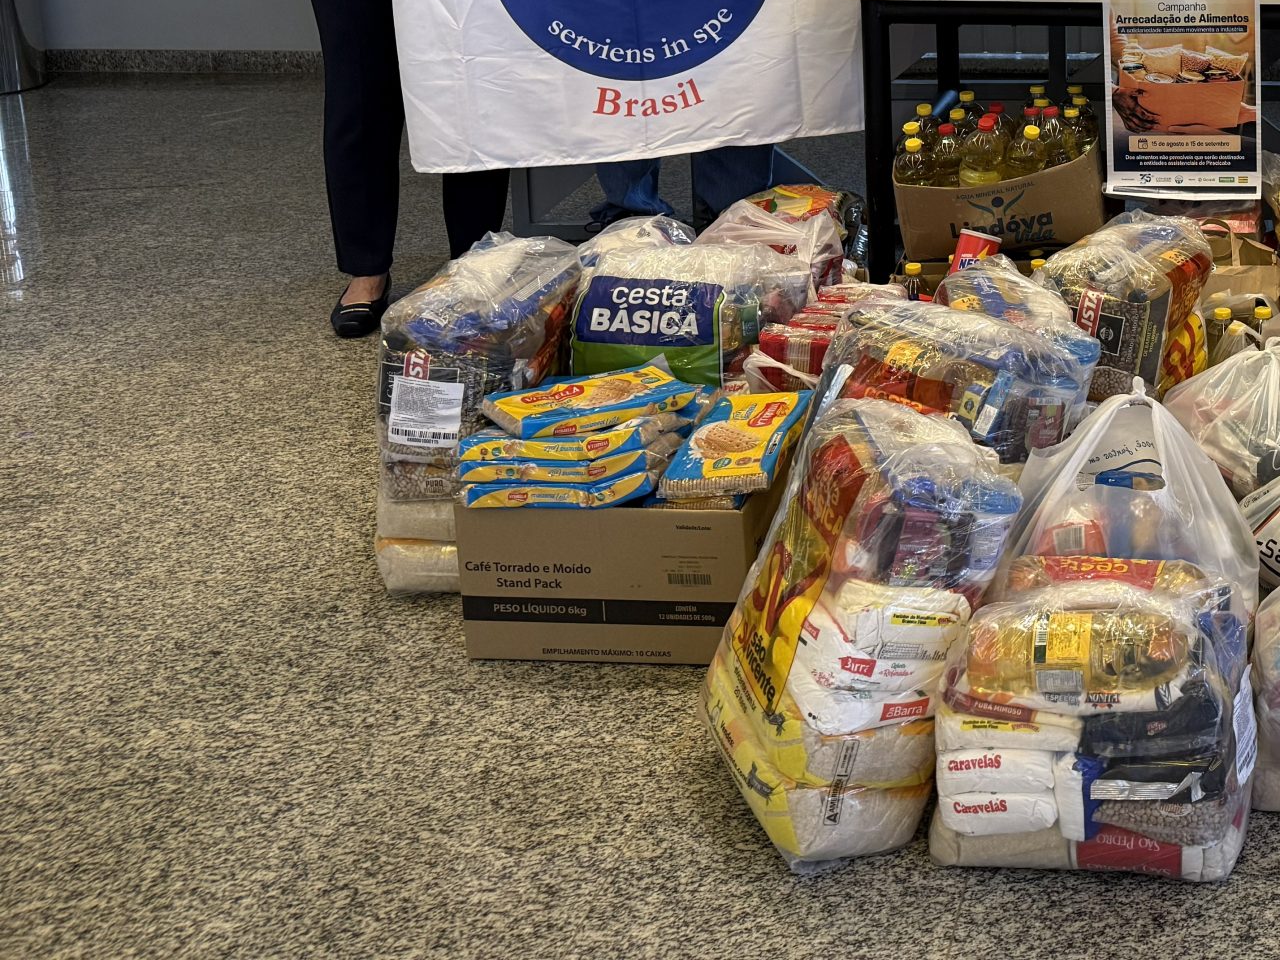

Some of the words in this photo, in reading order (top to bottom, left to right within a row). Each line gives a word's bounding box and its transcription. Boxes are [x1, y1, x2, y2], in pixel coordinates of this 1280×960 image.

[1158, 2, 1207, 14] Campanha
[1116, 14, 1181, 25] Arrecadação
[1184, 14, 1196, 23] de
[1199, 13, 1249, 23] Alimentos
[548, 19, 655, 65] serviens
[661, 36, 692, 60] in
[693, 6, 734, 46] spe
[593, 78, 704, 117] Brasil
[975, 189, 1005, 198] MINERAL
[1005, 181, 1035, 192] NATURAL
[611, 283, 687, 308] cesta
[589, 306, 699, 336] BÁSICA
[465, 561, 491, 573] Café
[493, 562, 539, 574] Torrado
[543, 565, 550, 574] e
[553, 563, 591, 575] Moído
[496, 577, 530, 589] Stand
[534, 577, 562, 589] Pack
[493, 603, 519, 615] PESO
[522, 602, 566, 617] LÍQUIDO
[568, 605, 587, 617] 6kg
[542, 646, 599, 656] EMPILHAMENTO
[600, 646, 634, 657] MÁXIMO:
[636, 649, 644, 657] 10
[646, 650, 672, 658] CAIXAS
[751, 631, 767, 664] são
[744, 641, 776, 703] vicente
[993, 705, 1022, 716] MIMOSO
[953, 799, 1007, 814] Caravelas
[1097, 833, 1134, 849] PEDRO
[1138, 840, 1161, 852] SÃO
